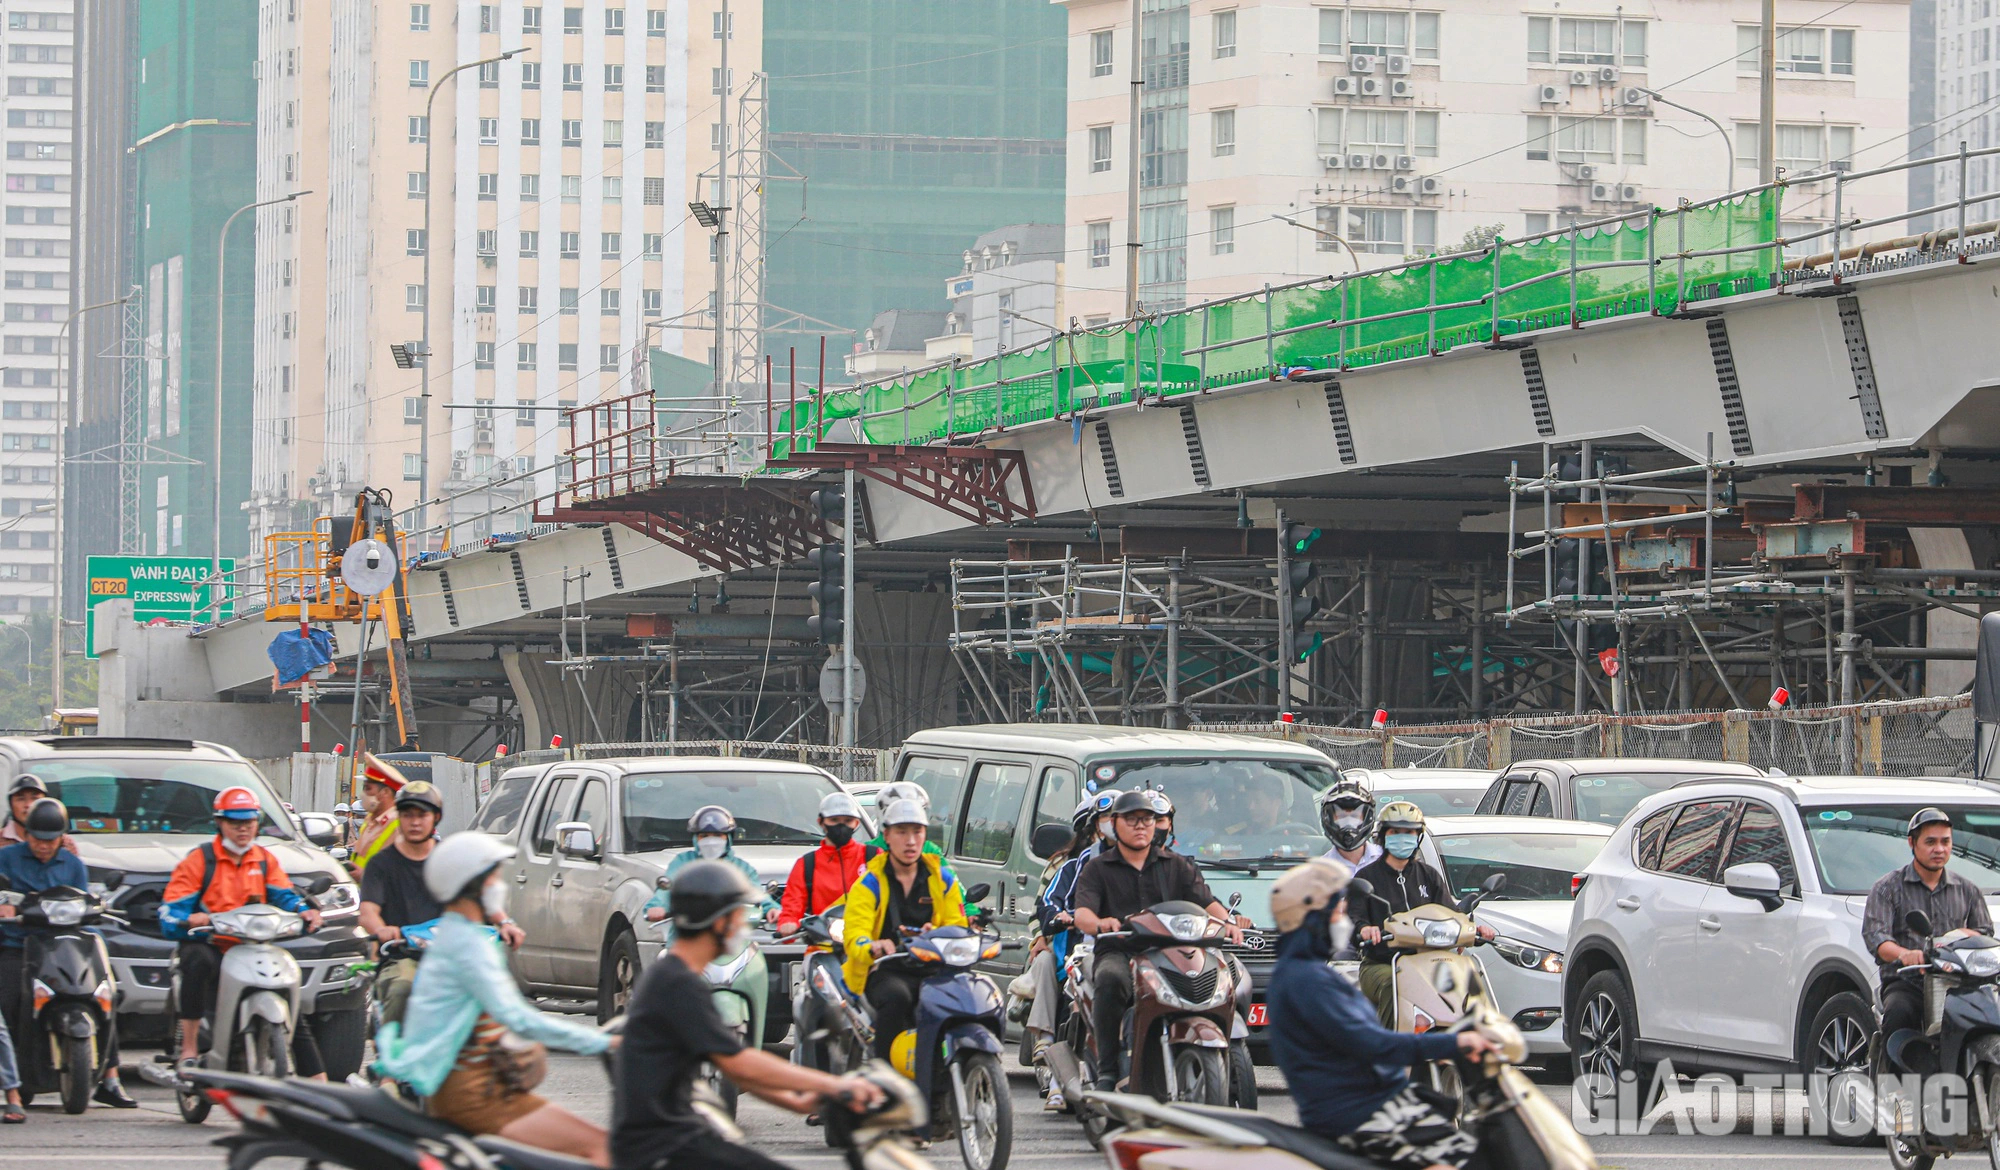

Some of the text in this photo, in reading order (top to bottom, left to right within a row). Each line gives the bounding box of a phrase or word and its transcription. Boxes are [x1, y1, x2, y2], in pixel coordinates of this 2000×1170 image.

[130, 563, 208, 581] VÀNH ĐAI 3
[91, 581, 126, 594] CT.20
[134, 591, 202, 603] EXPRESSWAY
[1248, 1006, 1267, 1024] 67
